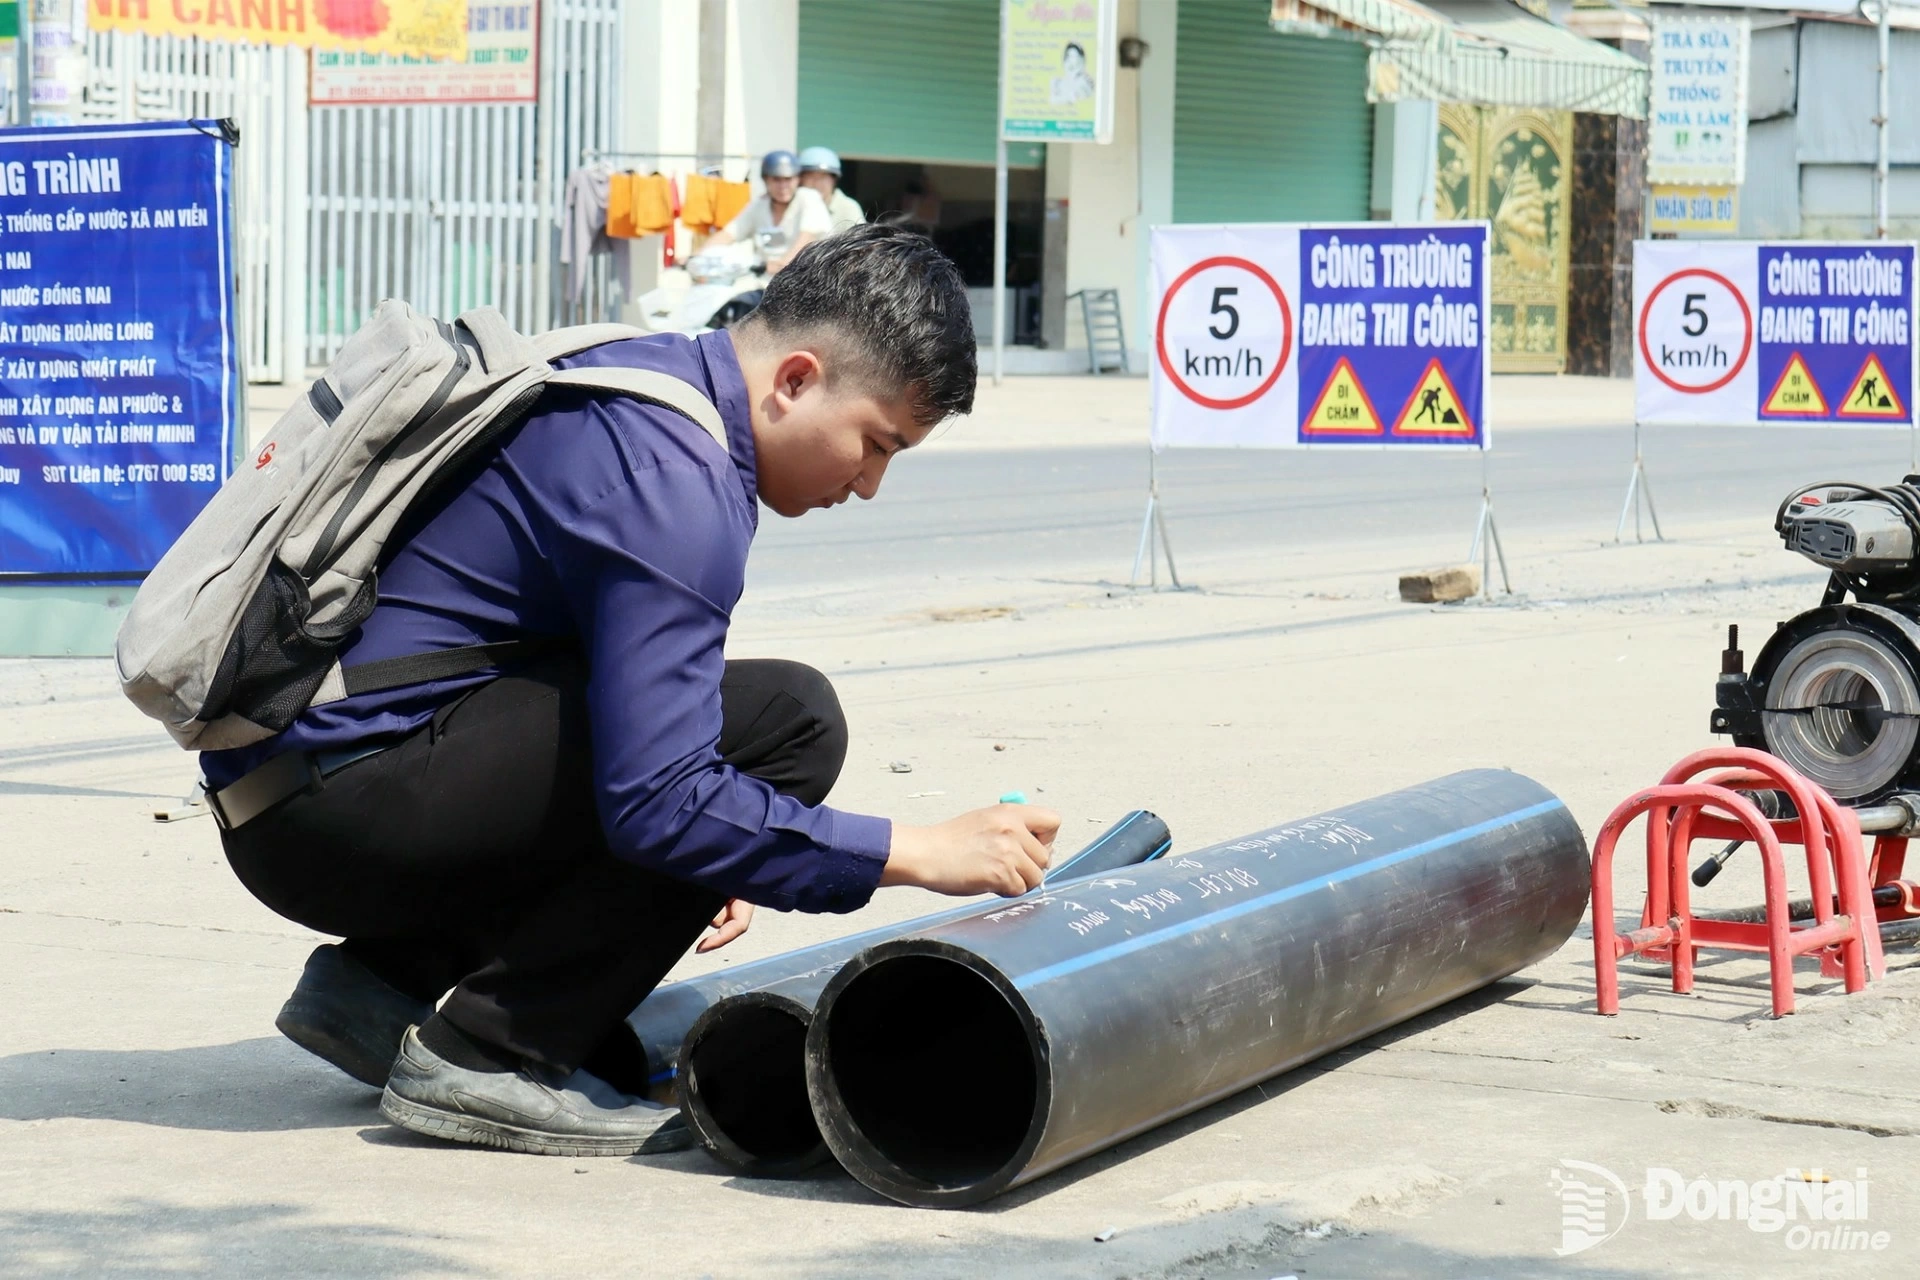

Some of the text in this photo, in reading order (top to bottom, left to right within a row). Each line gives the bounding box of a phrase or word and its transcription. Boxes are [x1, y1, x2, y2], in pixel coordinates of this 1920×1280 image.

[32, 152, 121, 195] TRÌNH
[6, 208, 53, 233] THỐNG
[56, 206, 85, 231] CẤP
[88, 207, 128, 230] NƯỚC
[131, 207, 151, 229] XÃ
[154, 209, 175, 228] AN
[6, 251, 31, 270] NAI
[1310, 233, 1472, 289] CÔNG TRƯỜNG
[1767, 250, 1902, 296] CÔNG TRƯỜNG
[1, 284, 40, 307] NƯỚC
[85, 286, 111, 305] NAI
[1208, 286, 1240, 341] 5
[1302, 293, 1478, 348] ĐANG THI CÔNG
[1681, 293, 1708, 337] 5
[1761, 300, 1908, 345] ĐANG THI CÔNG
[22, 323, 61, 346] DỰNG
[64, 320, 113, 342] HOÀNG
[117, 322, 153, 341] LONG
[7, 357, 36, 379] XÂY
[39, 359, 79, 383] DỰNG
[81, 356, 117, 382] NHẬT
[119, 355, 156, 378] PHÁT
[1184, 348, 1264, 377] km/h
[1662, 344, 1728, 368] km/h
[21, 394, 51, 416] XÂY
[55, 395, 94, 419] DỰNG
[98, 397, 119, 415] AN
[122, 391, 168, 414] PHƯỚC
[171, 395, 183, 414] &
[17, 423, 36, 445] VÀ
[39, 426, 59, 445] DV
[62, 422, 92, 448] VẬN
[95, 419, 118, 444] TẢI
[120, 421, 153, 444] BÌNH
[156, 425, 195, 443] MINH
[69, 465, 100, 483] Liên
[103, 464, 125, 486] hệ:
[127, 464, 159, 482] 0767
[162, 464, 188, 482] 000
[189, 463, 216, 482] 593
